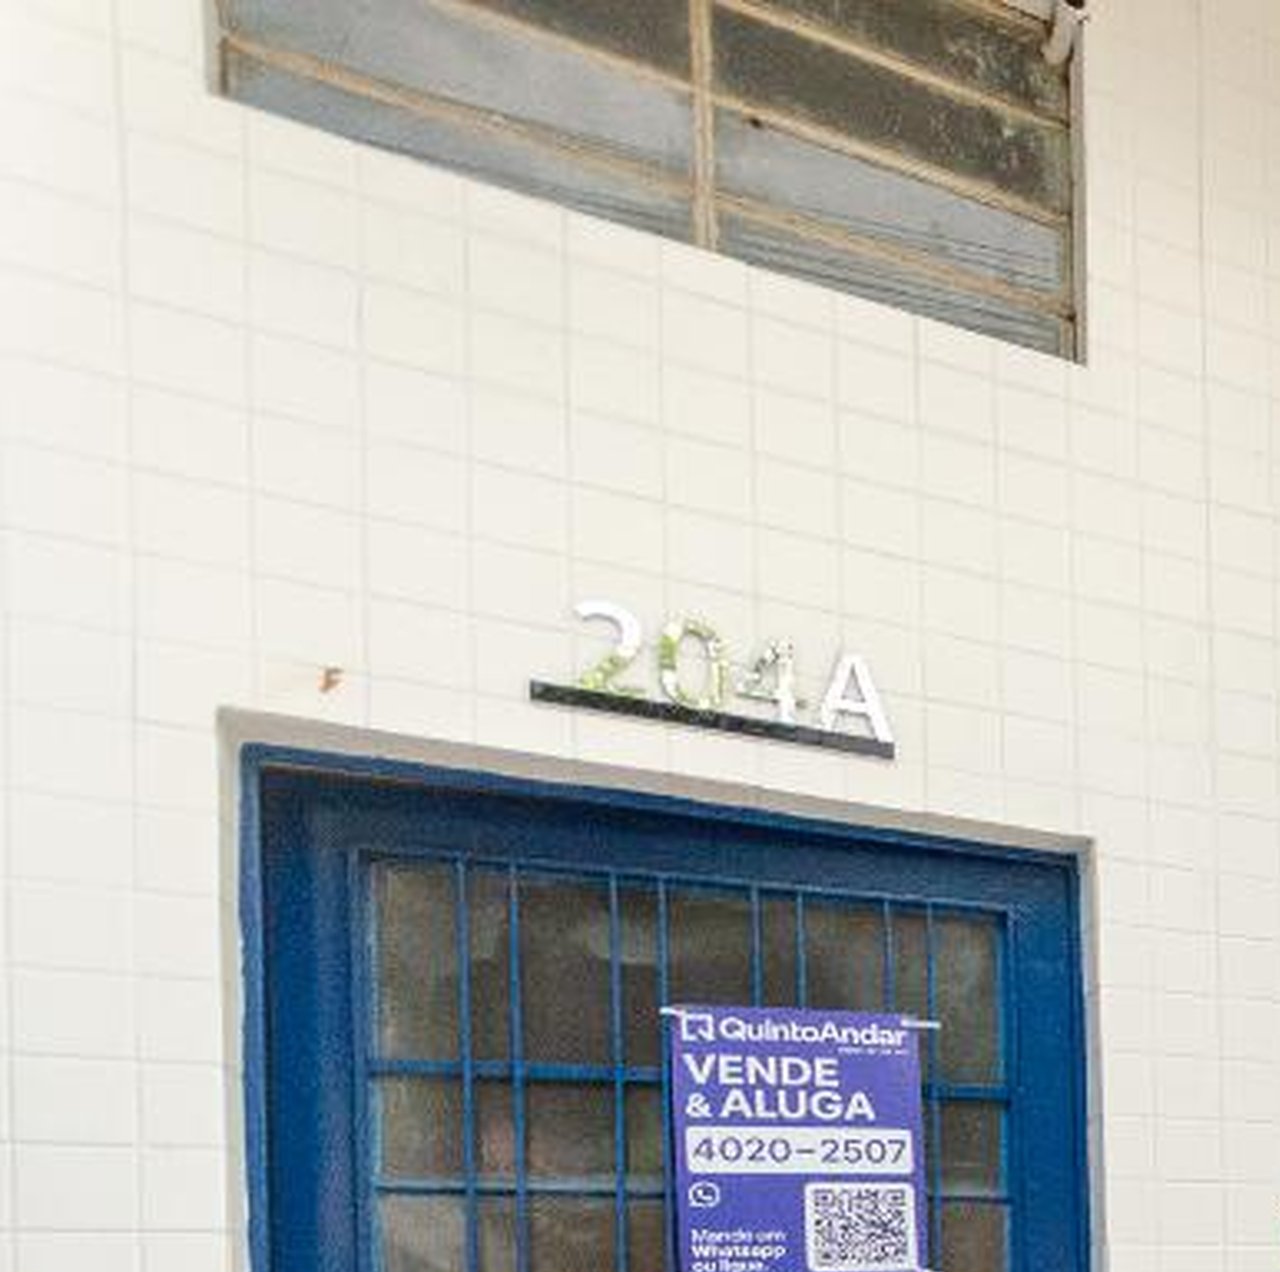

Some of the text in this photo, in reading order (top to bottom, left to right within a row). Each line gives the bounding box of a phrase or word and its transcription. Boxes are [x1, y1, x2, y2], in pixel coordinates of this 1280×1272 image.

[572, 599, 894, 742] 204A
[719, 1015, 907, 1046] QuintoAndar
[682, 1053, 840, 1088] VENDE
[685, 1088, 876, 1121] & ALUGA
[693, 1136, 907, 1165] 4020-2507
